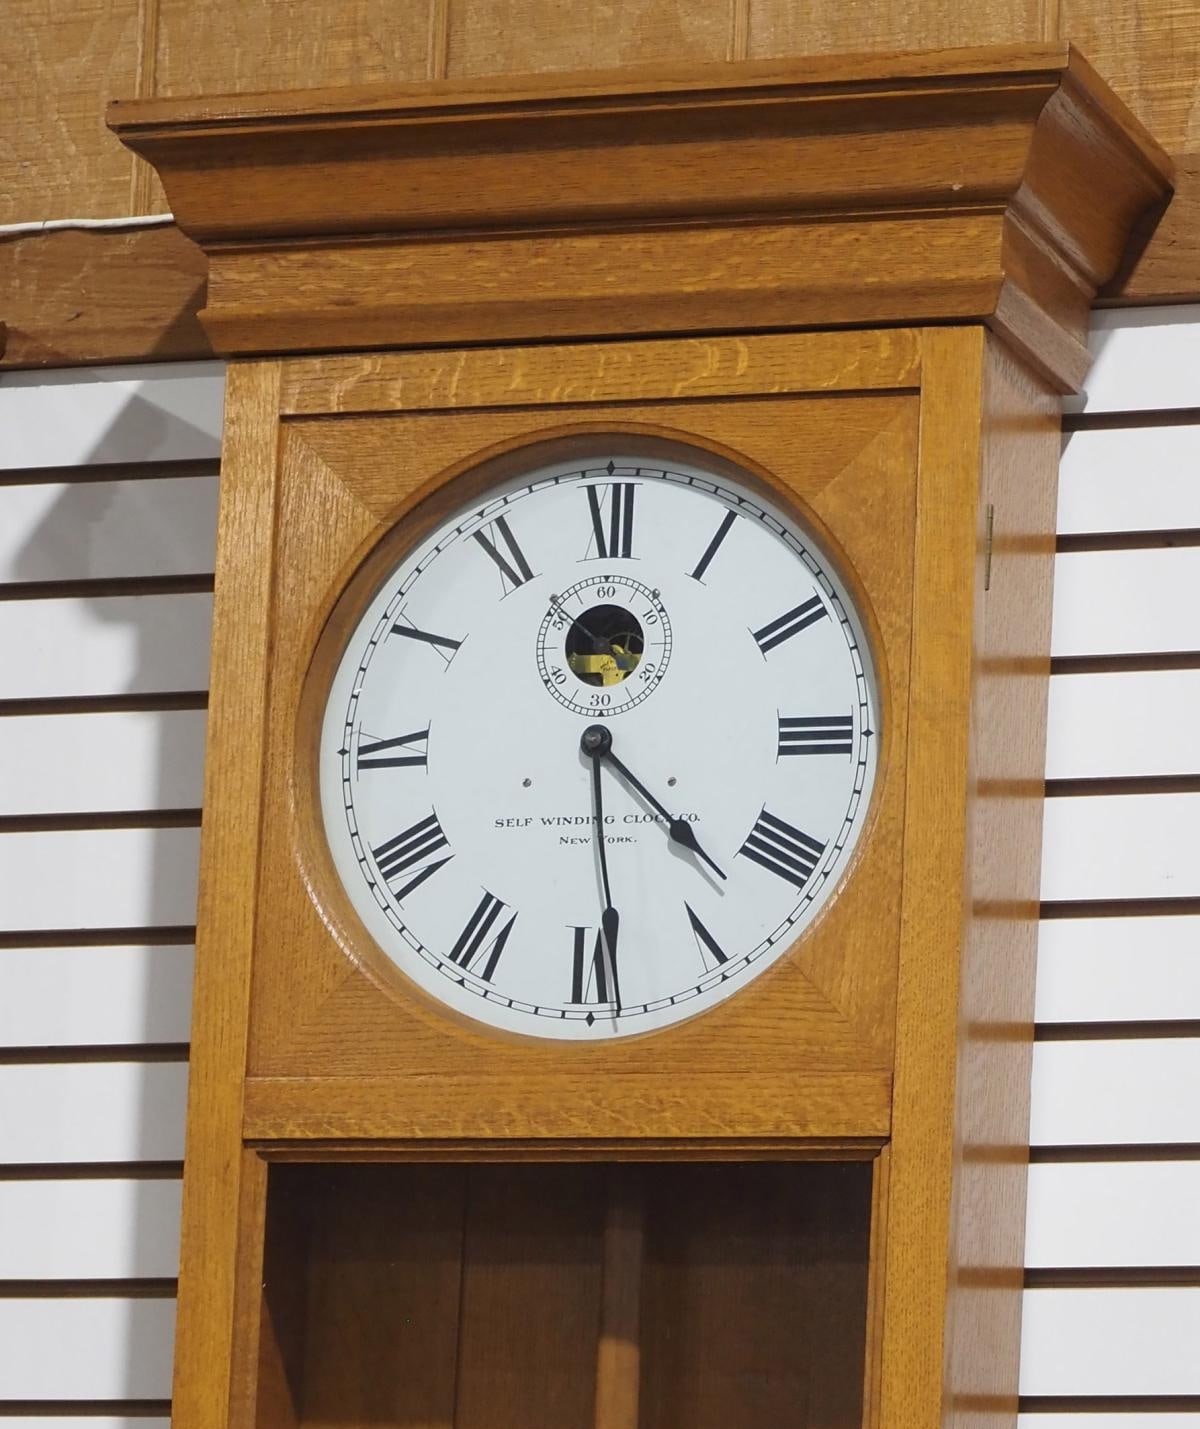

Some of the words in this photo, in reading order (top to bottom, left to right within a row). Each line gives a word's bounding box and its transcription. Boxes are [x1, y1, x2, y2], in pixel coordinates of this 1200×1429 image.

[463, 509, 543, 601] XI
[576, 482, 643, 562] XII
[685, 506, 746, 586] I
[553, 610, 570, 631] 50
[597, 585, 616, 598] 60
[642, 609, 658, 626] 10
[747, 586, 832, 662] II
[384, 602, 469, 673] X
[550, 664, 567, 685] 40
[589, 693, 611, 707] 30
[639, 662, 656, 683] 20
[356, 719, 431, 782] IX
[775, 704, 853, 765] III
[494, 816, 533, 828] SELF
[623, 813, 676, 824] CLOC
[679, 812, 701, 823] CO.
[733, 802, 830, 895] IIII
[368, 804, 456, 910] VIII
[441, 885, 519, 986] VII
[684, 900, 738, 978] V
